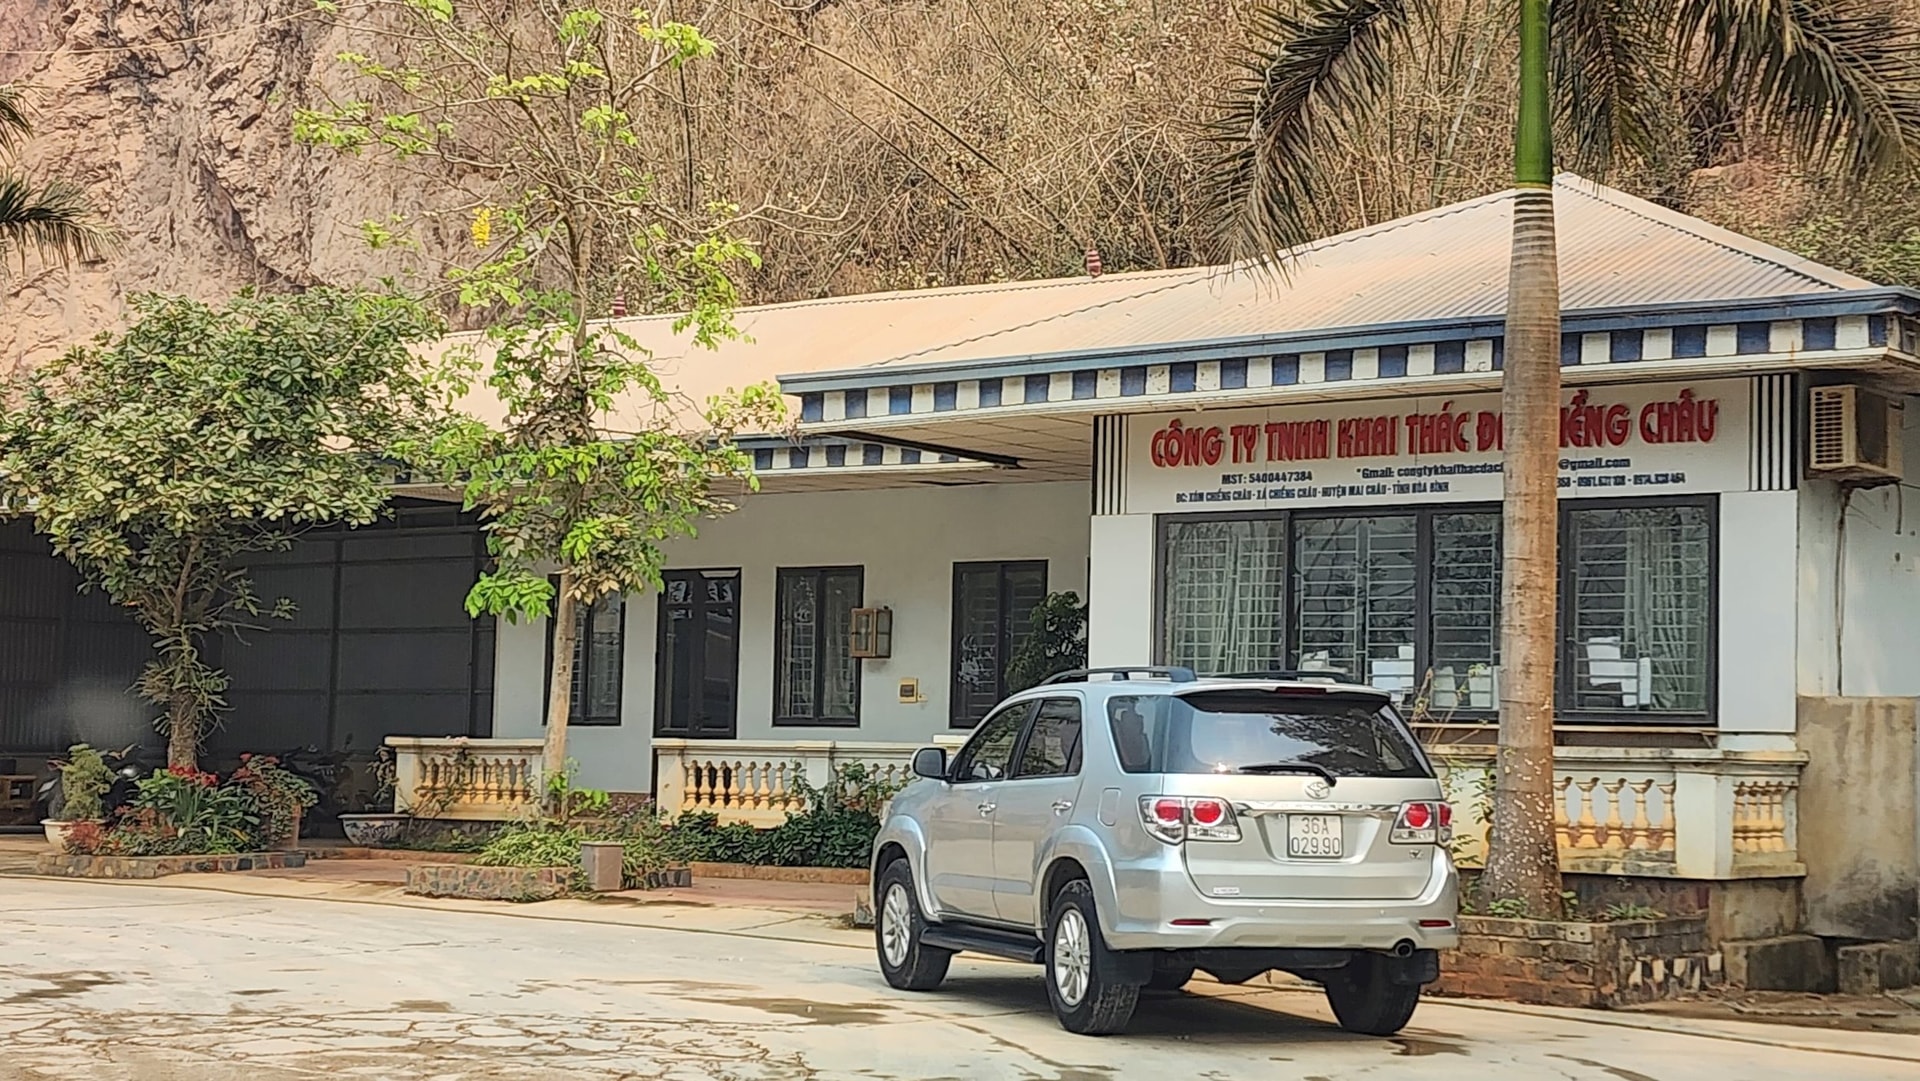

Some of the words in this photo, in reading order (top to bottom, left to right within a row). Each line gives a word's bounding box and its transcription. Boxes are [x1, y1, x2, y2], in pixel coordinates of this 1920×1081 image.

[1151, 418, 1224, 467] CÔNG
[1230, 424, 1260, 463] TY
[1265, 419, 1331, 461] TNHH
[1337, 416, 1399, 458] KHAI
[1405, 400, 1471, 455] THÁC
[1639, 388, 1719, 443] CHÂU
[1221, 473, 1247, 485] MST:
[1249, 471, 1313, 484] 5400447384
[1301, 817, 1330, 835] 36A
[1291, 836, 1341, 855] 029.90
